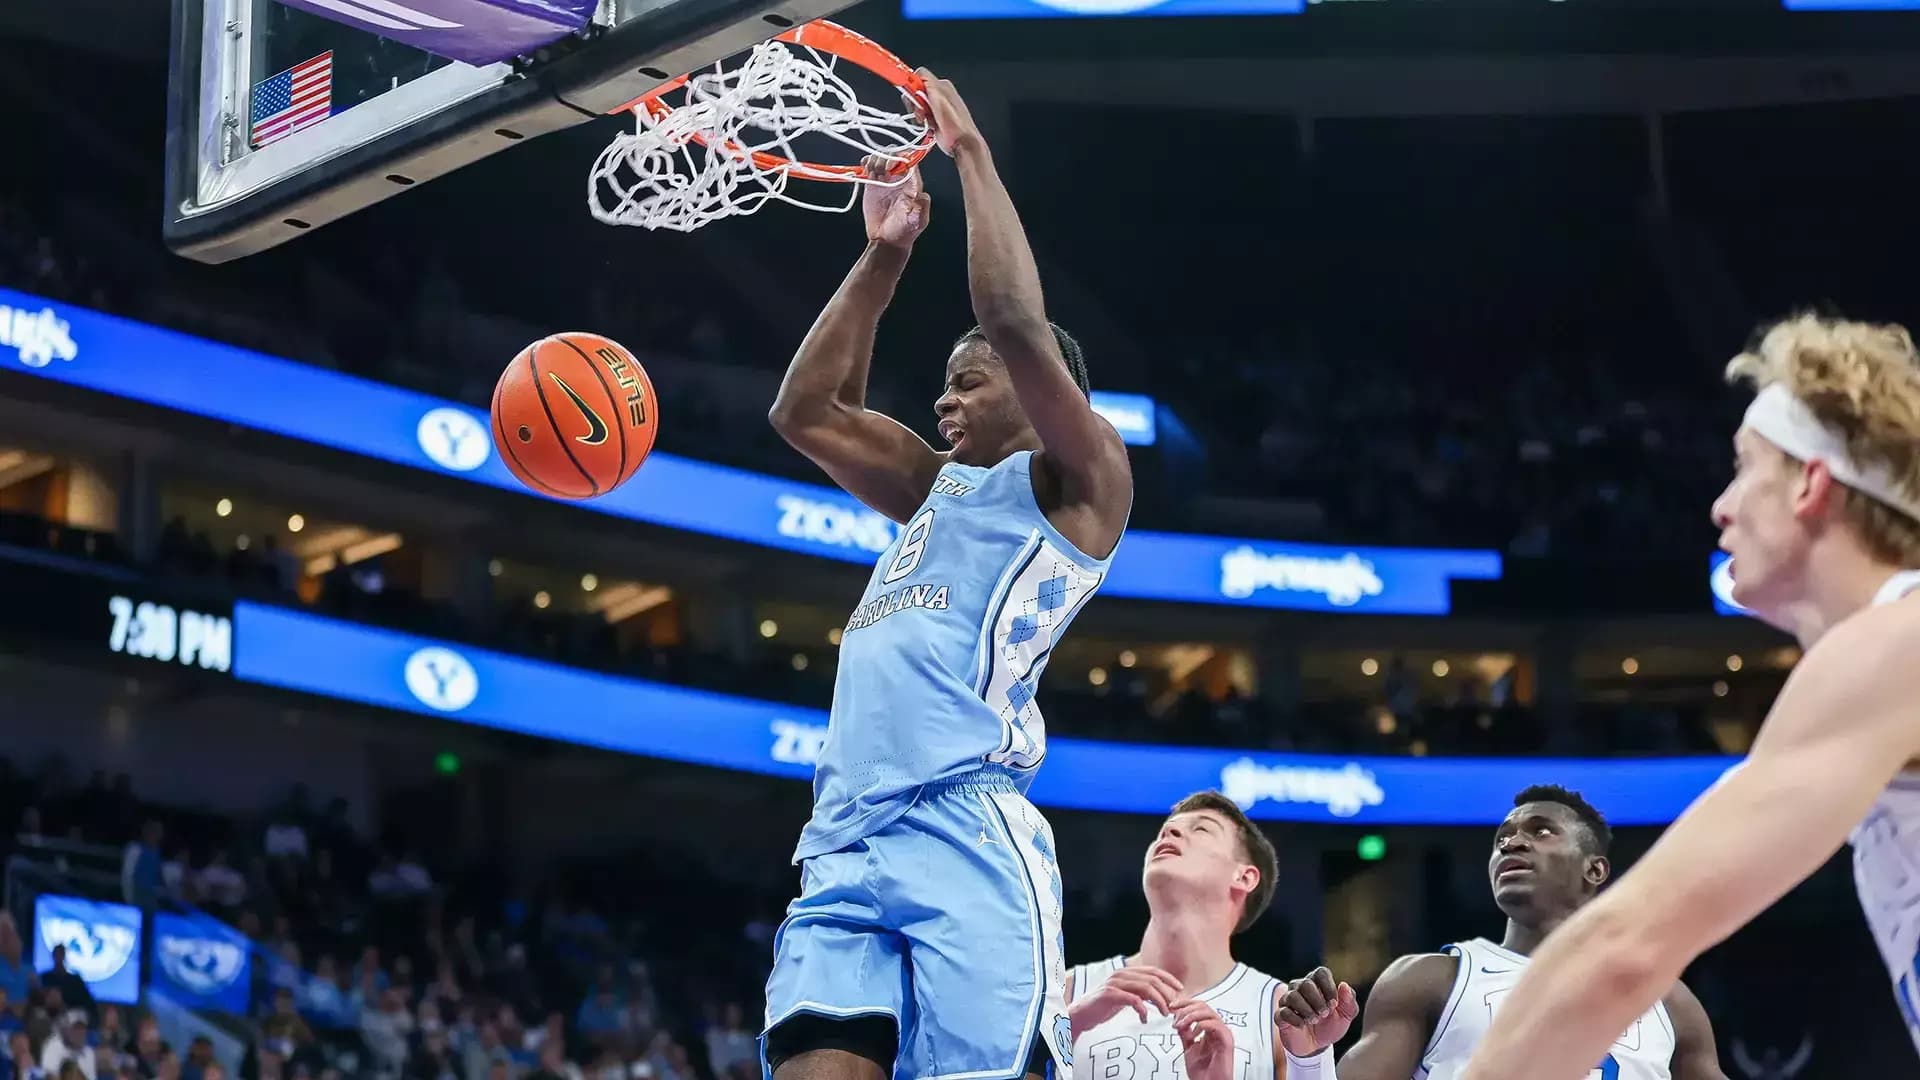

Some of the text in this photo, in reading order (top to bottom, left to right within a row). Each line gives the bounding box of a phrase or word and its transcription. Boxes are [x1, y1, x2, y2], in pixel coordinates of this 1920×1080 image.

[595, 347, 646, 427] ELITE
[883, 507, 936, 585] 8
[845, 584, 950, 633] CAROLINA
[179, 610, 232, 672] PM
[1089, 1033, 1252, 1080] BY
